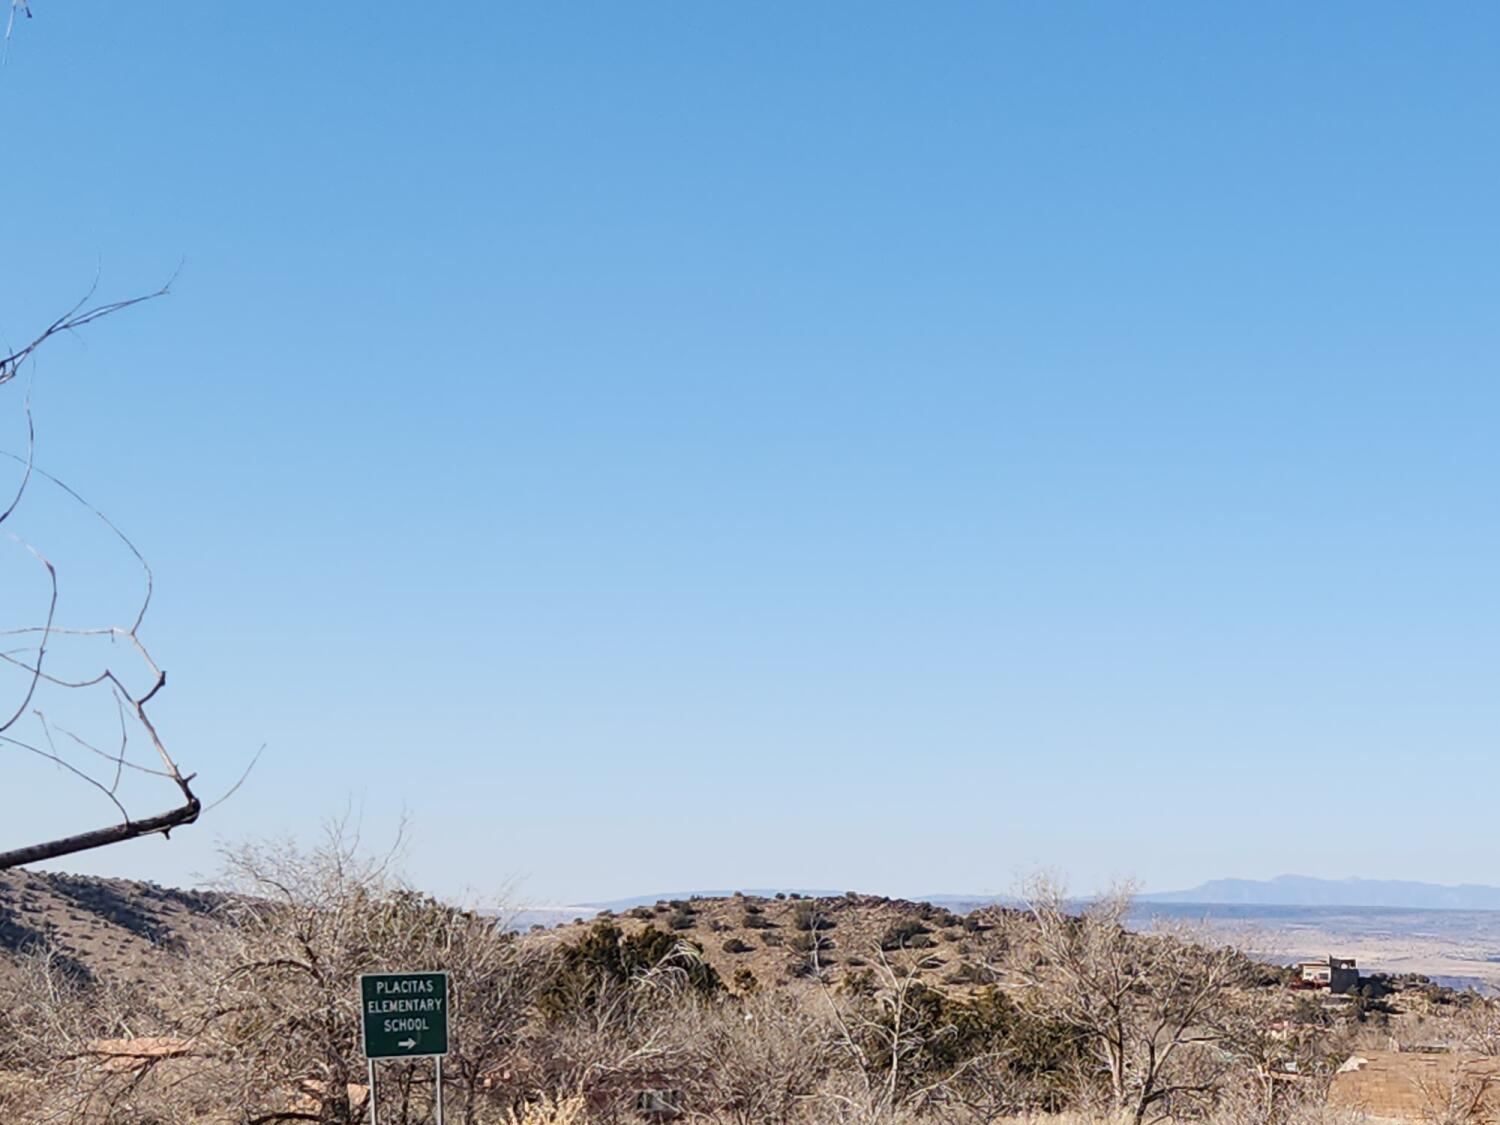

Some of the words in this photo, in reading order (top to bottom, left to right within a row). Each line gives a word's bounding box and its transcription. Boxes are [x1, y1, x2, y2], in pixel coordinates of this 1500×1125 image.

[376, 980, 434, 994] PLACITAS
[368, 997, 443, 1013] ELEMENTARY
[384, 1018, 430, 1032] SCHOOL
